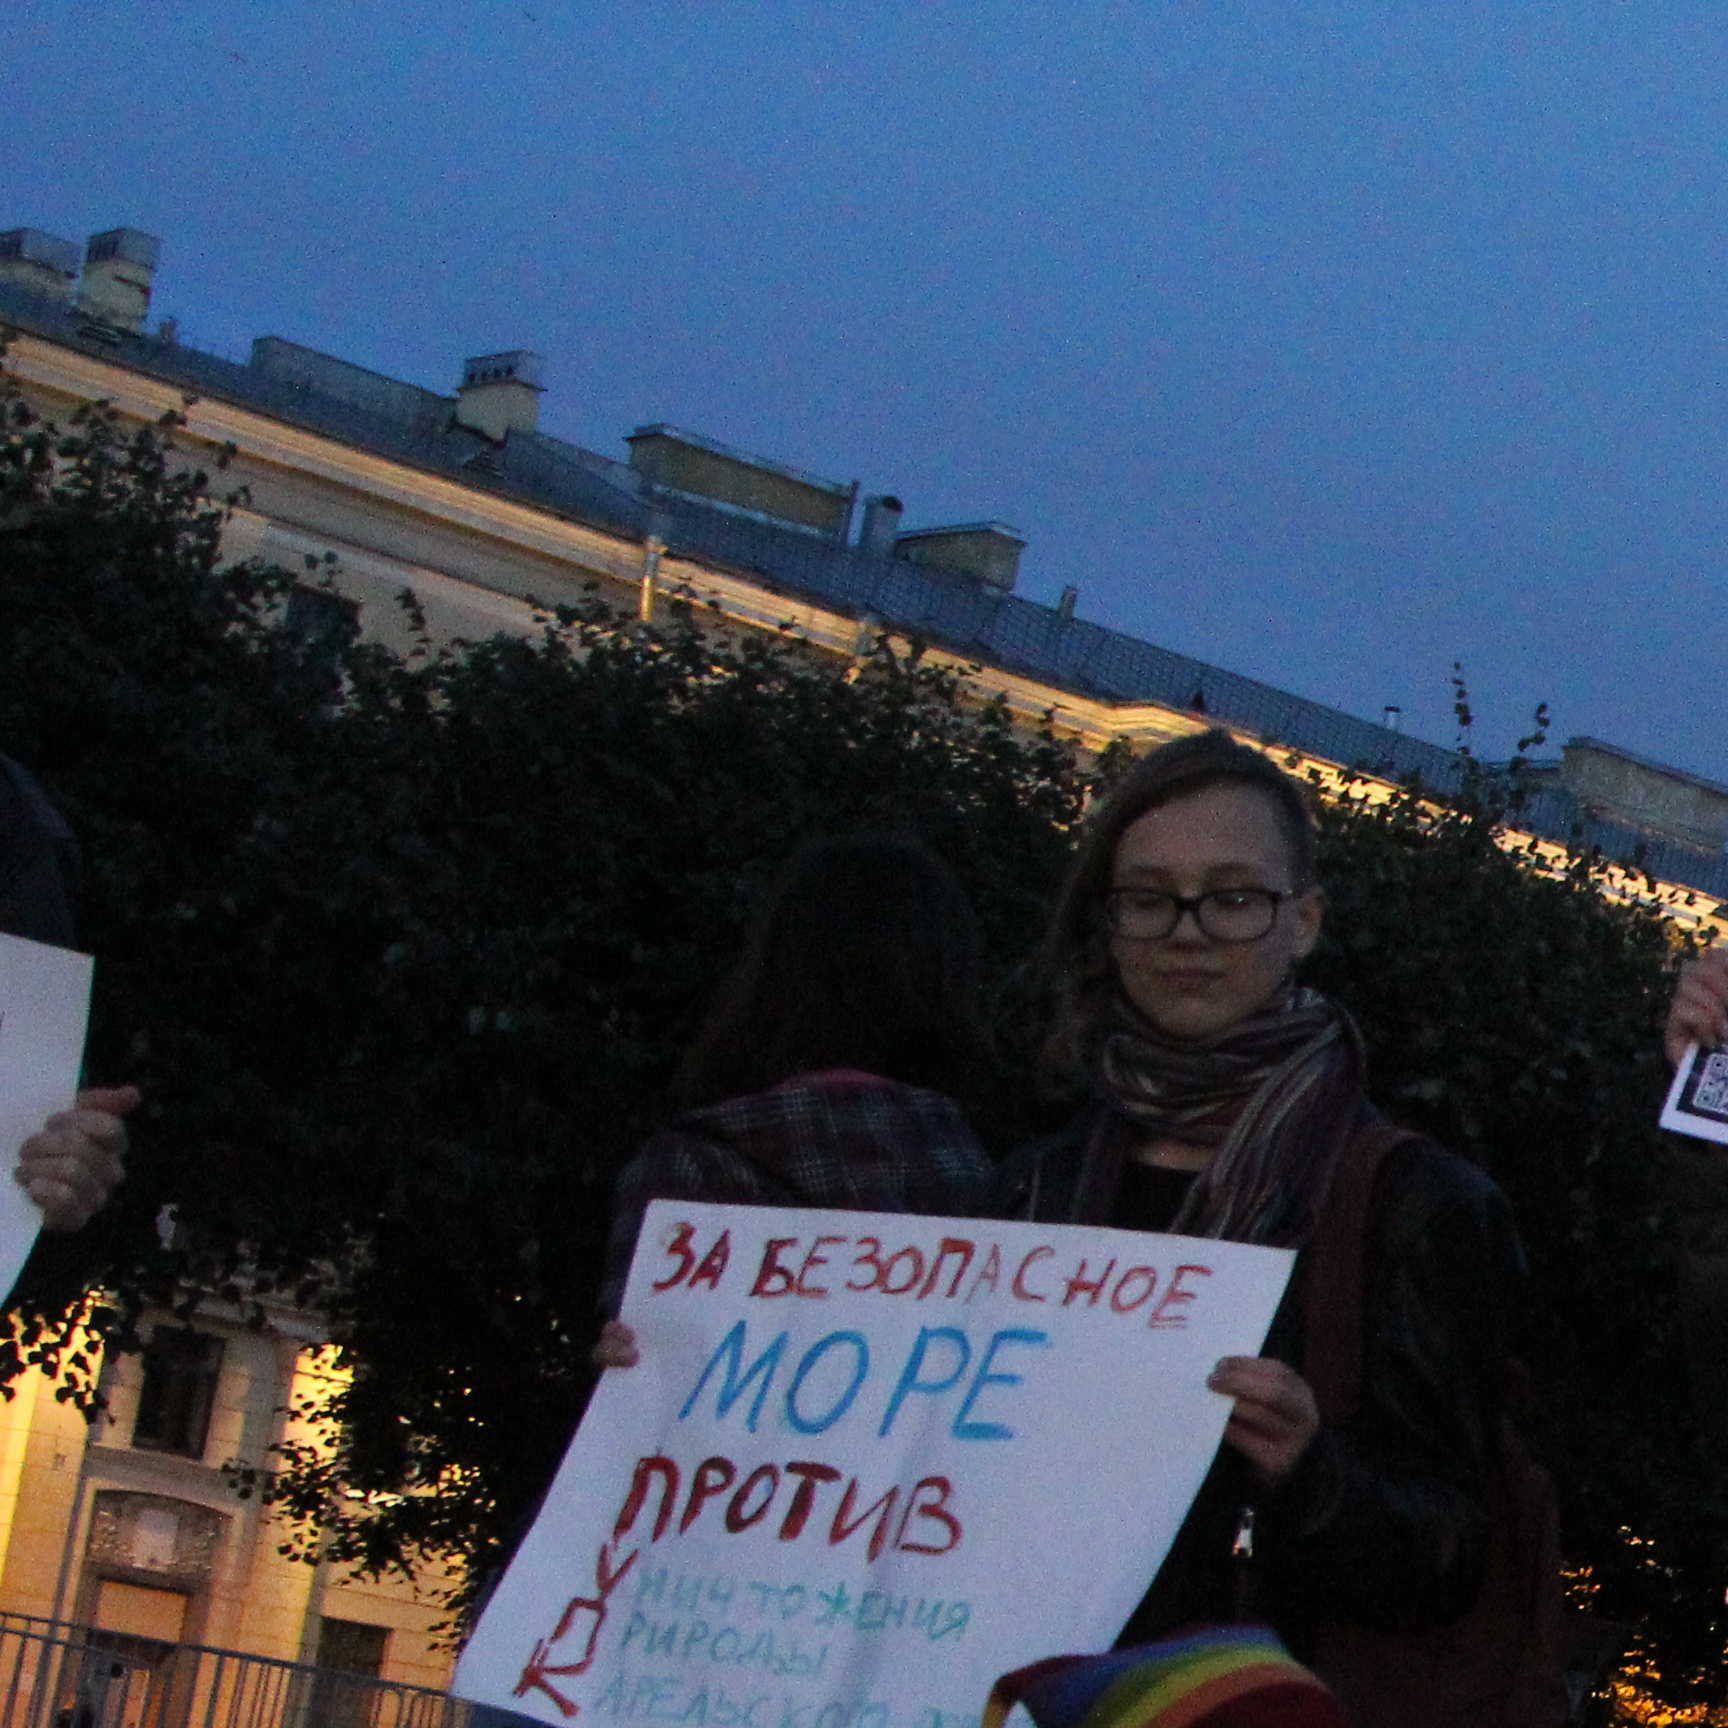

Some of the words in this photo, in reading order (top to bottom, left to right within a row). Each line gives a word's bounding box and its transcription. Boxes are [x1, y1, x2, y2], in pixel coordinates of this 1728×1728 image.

[652, 1221, 730, 1292] ЗА
[750, 1235, 1213, 1329] БЕЗОПАСНОЕ
[677, 1319, 1050, 1440] МОРЕ
[612, 1455, 964, 1565] ПРОТИВ
